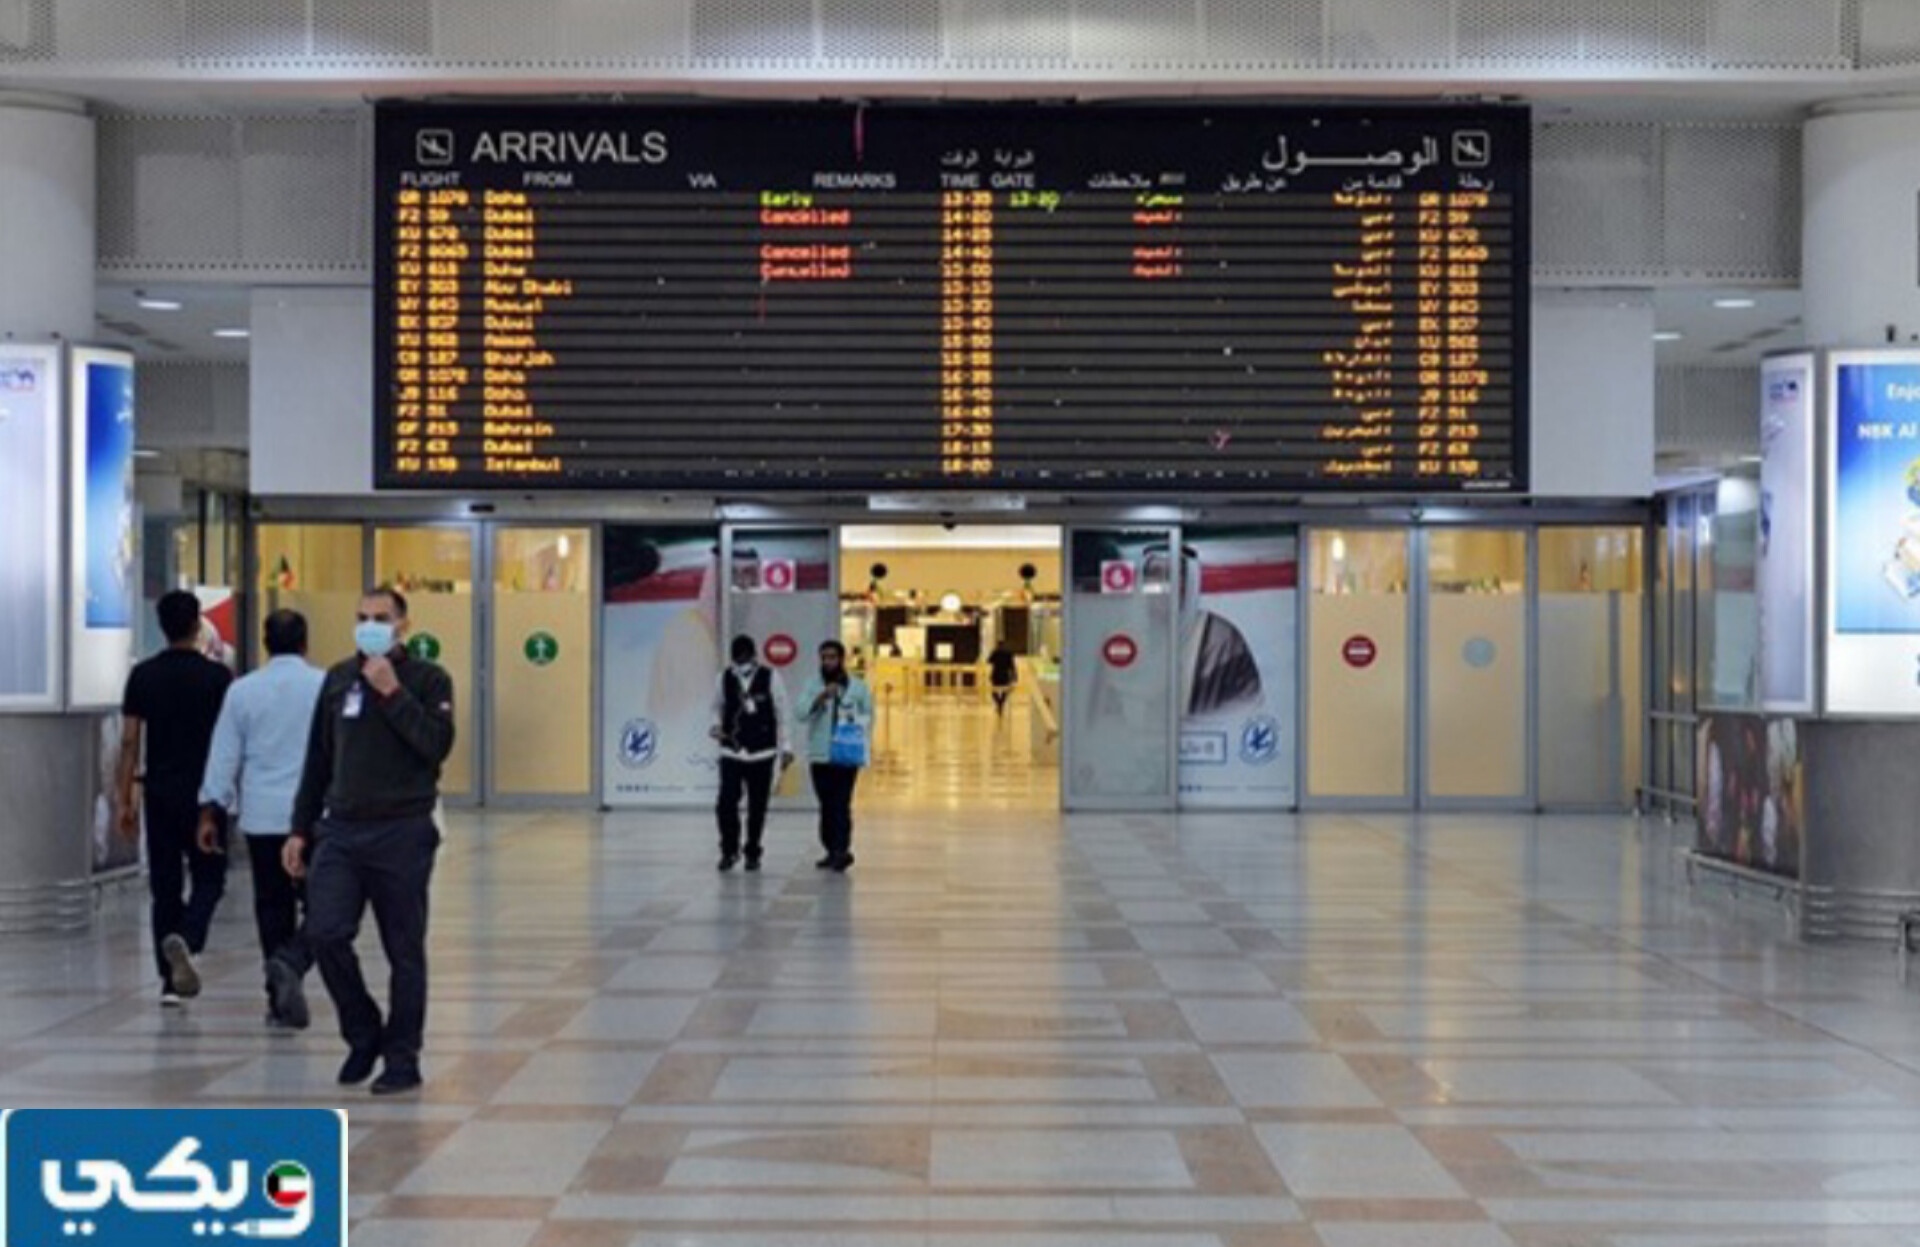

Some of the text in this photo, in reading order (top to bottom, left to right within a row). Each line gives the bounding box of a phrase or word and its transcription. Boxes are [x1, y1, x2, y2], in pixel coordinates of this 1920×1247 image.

[472, 132, 667, 163] ARRIVALS
[400, 171, 460, 187] FLIGHT
[522, 172, 573, 186] FROM
[688, 173, 717, 188] VIA
[813, 173, 896, 188] REMARKS
[941, 173, 979, 189] TIME
[991, 173, 1034, 189] GATE
[760, 189, 814, 208] Early
[484, 207, 534, 223] Dubai
[760, 209, 850, 224] Cancelled
[484, 226, 534, 241] Dubai
[484, 243, 534, 259] Dubai
[760, 245, 850, 260] Cancelled
[760, 262, 850, 278] Cancelled
[483, 403, 533, 418] Dubai
[483, 439, 533, 454] Dubai
